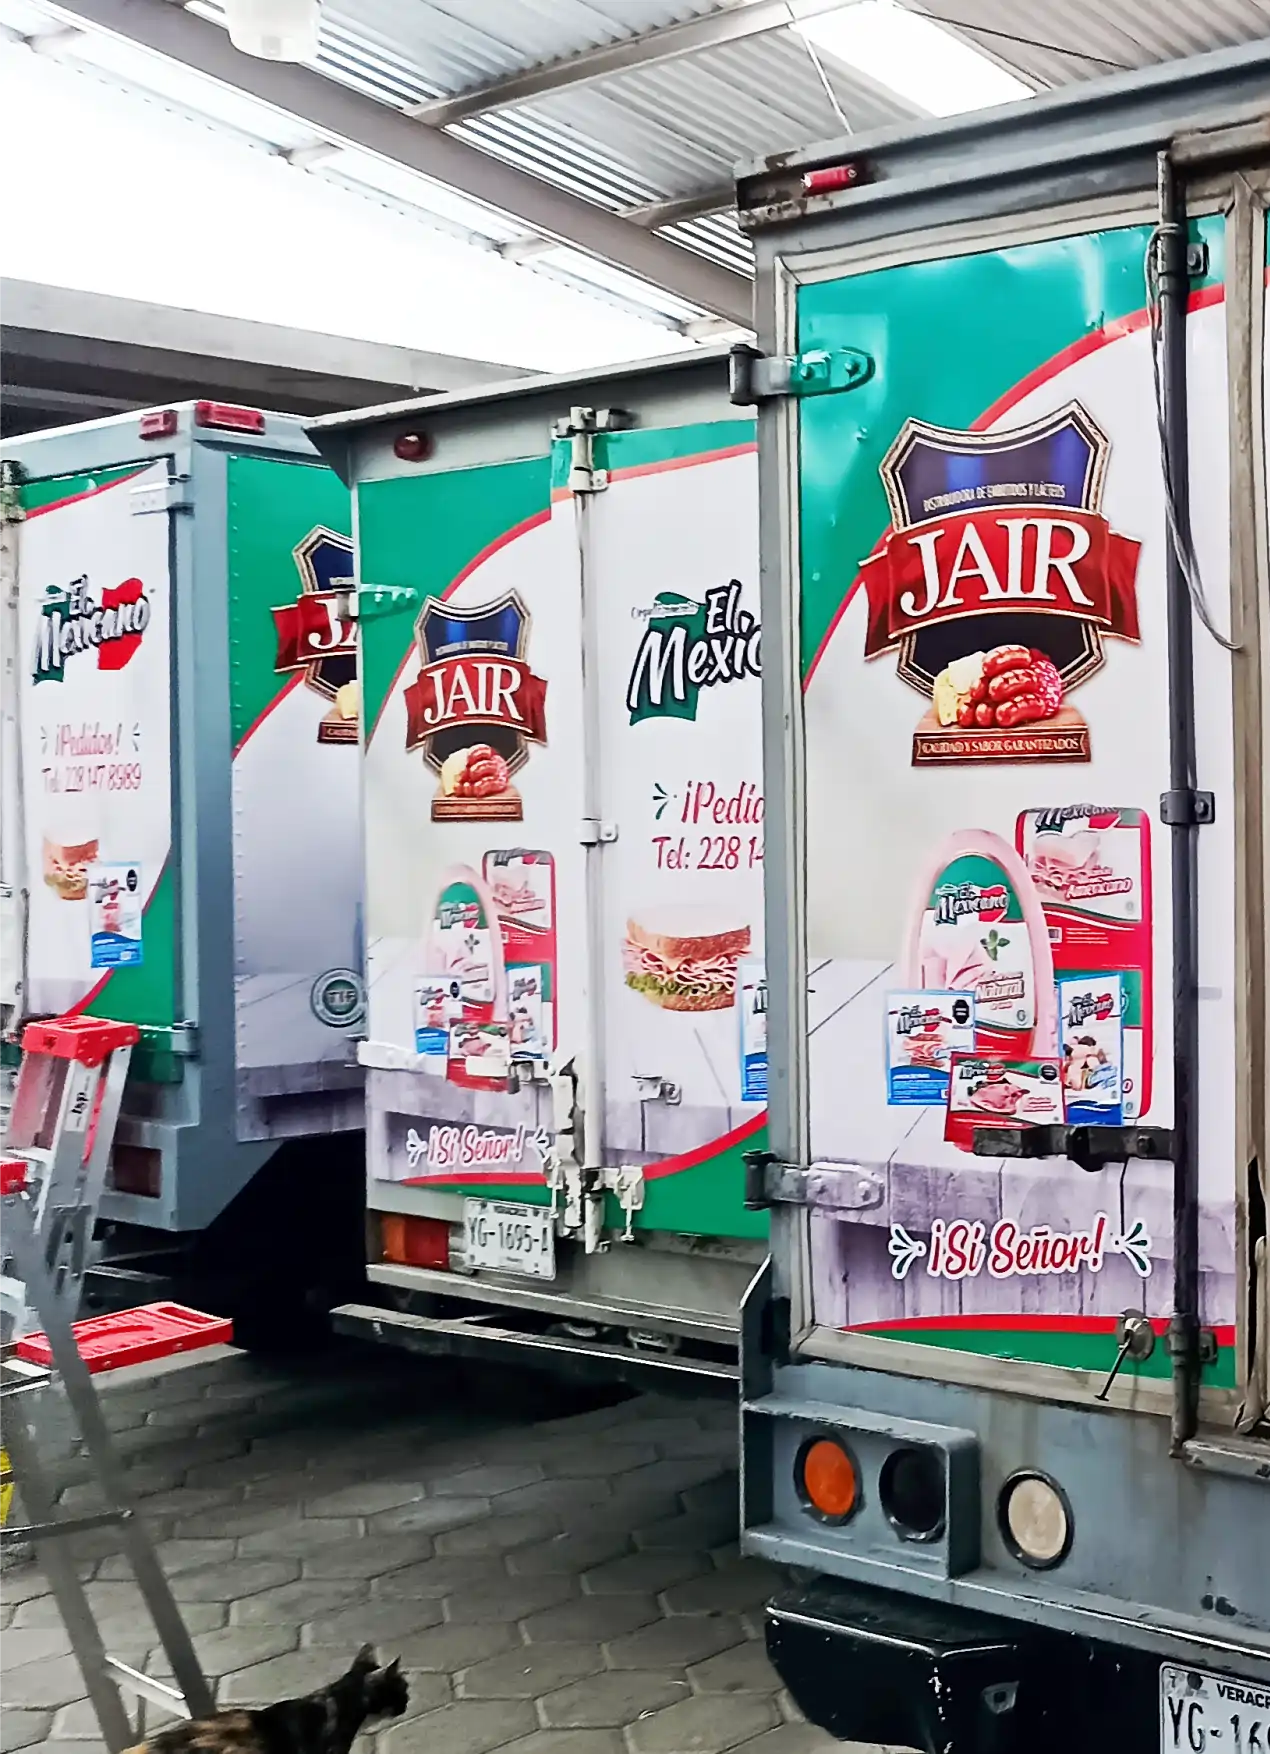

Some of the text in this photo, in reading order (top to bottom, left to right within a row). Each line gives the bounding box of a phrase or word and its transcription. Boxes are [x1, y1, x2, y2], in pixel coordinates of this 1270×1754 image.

[900, 516, 1094, 617] JAIR
[705, 579, 741, 635] El
[423, 663, 524, 725] JAIR
[651, 836, 690, 869] Tel:
[696, 836, 741, 870] 228
